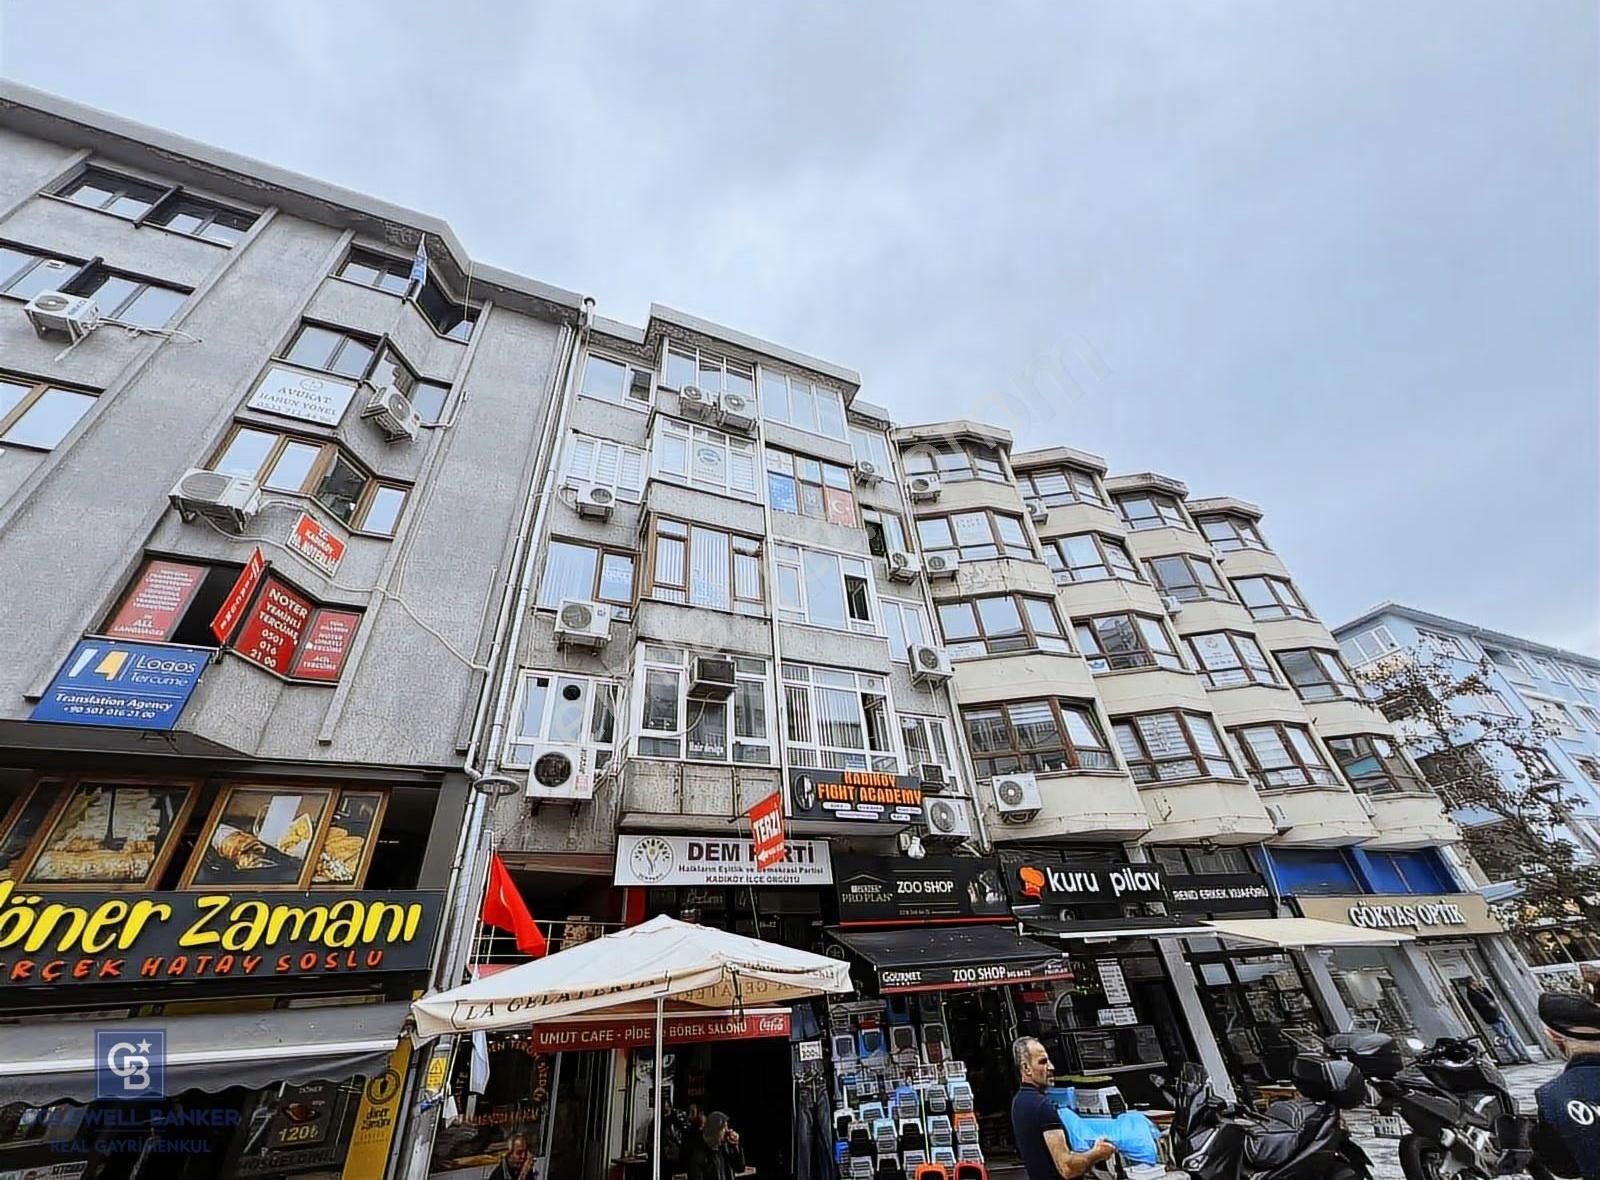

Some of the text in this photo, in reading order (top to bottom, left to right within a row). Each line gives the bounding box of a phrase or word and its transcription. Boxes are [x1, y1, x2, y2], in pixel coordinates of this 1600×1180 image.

[268, 588, 308, 619] NOTER
[262, 629, 284, 645] 0501
[136, 655, 196, 674] Logos
[264, 656, 277, 668] 00
[55, 693, 173, 712] Translation Agency
[817, 783, 921, 805] FIGHT ACADEMY
[687, 842, 740, 861] DEM
[748, 842, 814, 863] PRTİ
[896, 881, 922, 894] ZOO
[924, 880, 954, 893] SHOP
[1047, 867, 1162, 897] kuru pilav
[0, 880, 423, 953] öner Zamanı
[1349, 899, 1466, 931] GÖKTAŞ OPTİK
[141, 954, 262, 977] HATAY
[275, 950, 383, 973] SOSLU
[952, 968, 976, 982] ZOO
[977, 966, 1006, 981] SHOP
[464, 1001, 495, 1021] LA
[539, 1031, 578, 1045] UMUT
[581, 1029, 613, 1043] CAFE
[625, 1025, 651, 1040] PİDE
[669, 1020, 747, 1037] BÖREK SALONU
